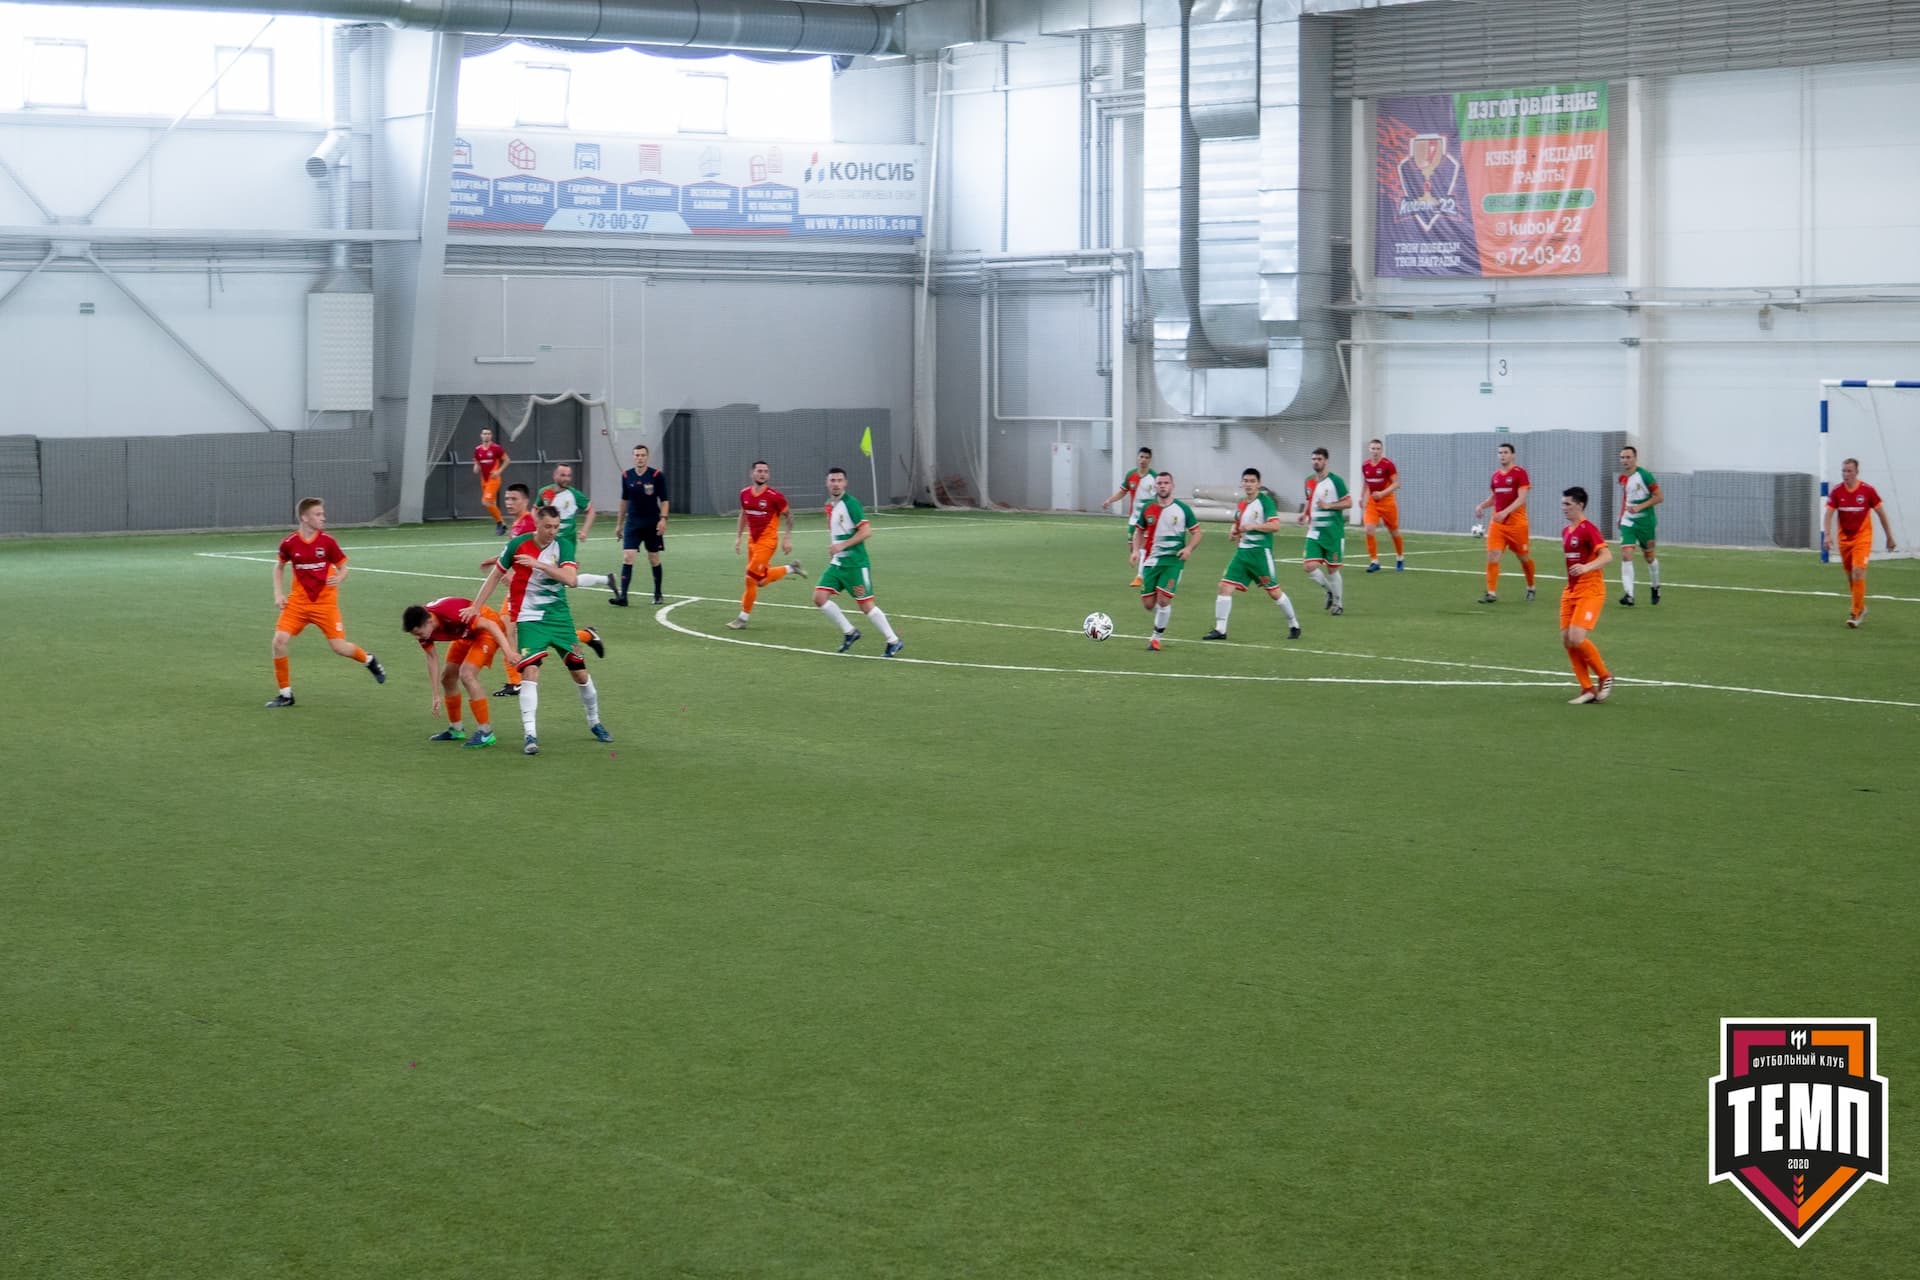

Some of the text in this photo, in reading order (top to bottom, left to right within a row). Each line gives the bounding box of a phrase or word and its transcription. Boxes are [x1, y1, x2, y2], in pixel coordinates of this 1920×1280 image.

[1467, 91, 1598, 120] ИЗГОТОВЛЕНИЕ
[1485, 144, 1596, 166] КУБКИ МЕДАЛИ
[829, 161, 915, 181] КОНСИБ
[587, 212, 649, 230] 73-00-37
[804, 215, 918, 231] www.konsib.com
[1509, 216, 1582, 236] kubok_22
[1509, 244, 1582, 265] 72-03-23
[1498, 359, 1508, 377] 3
